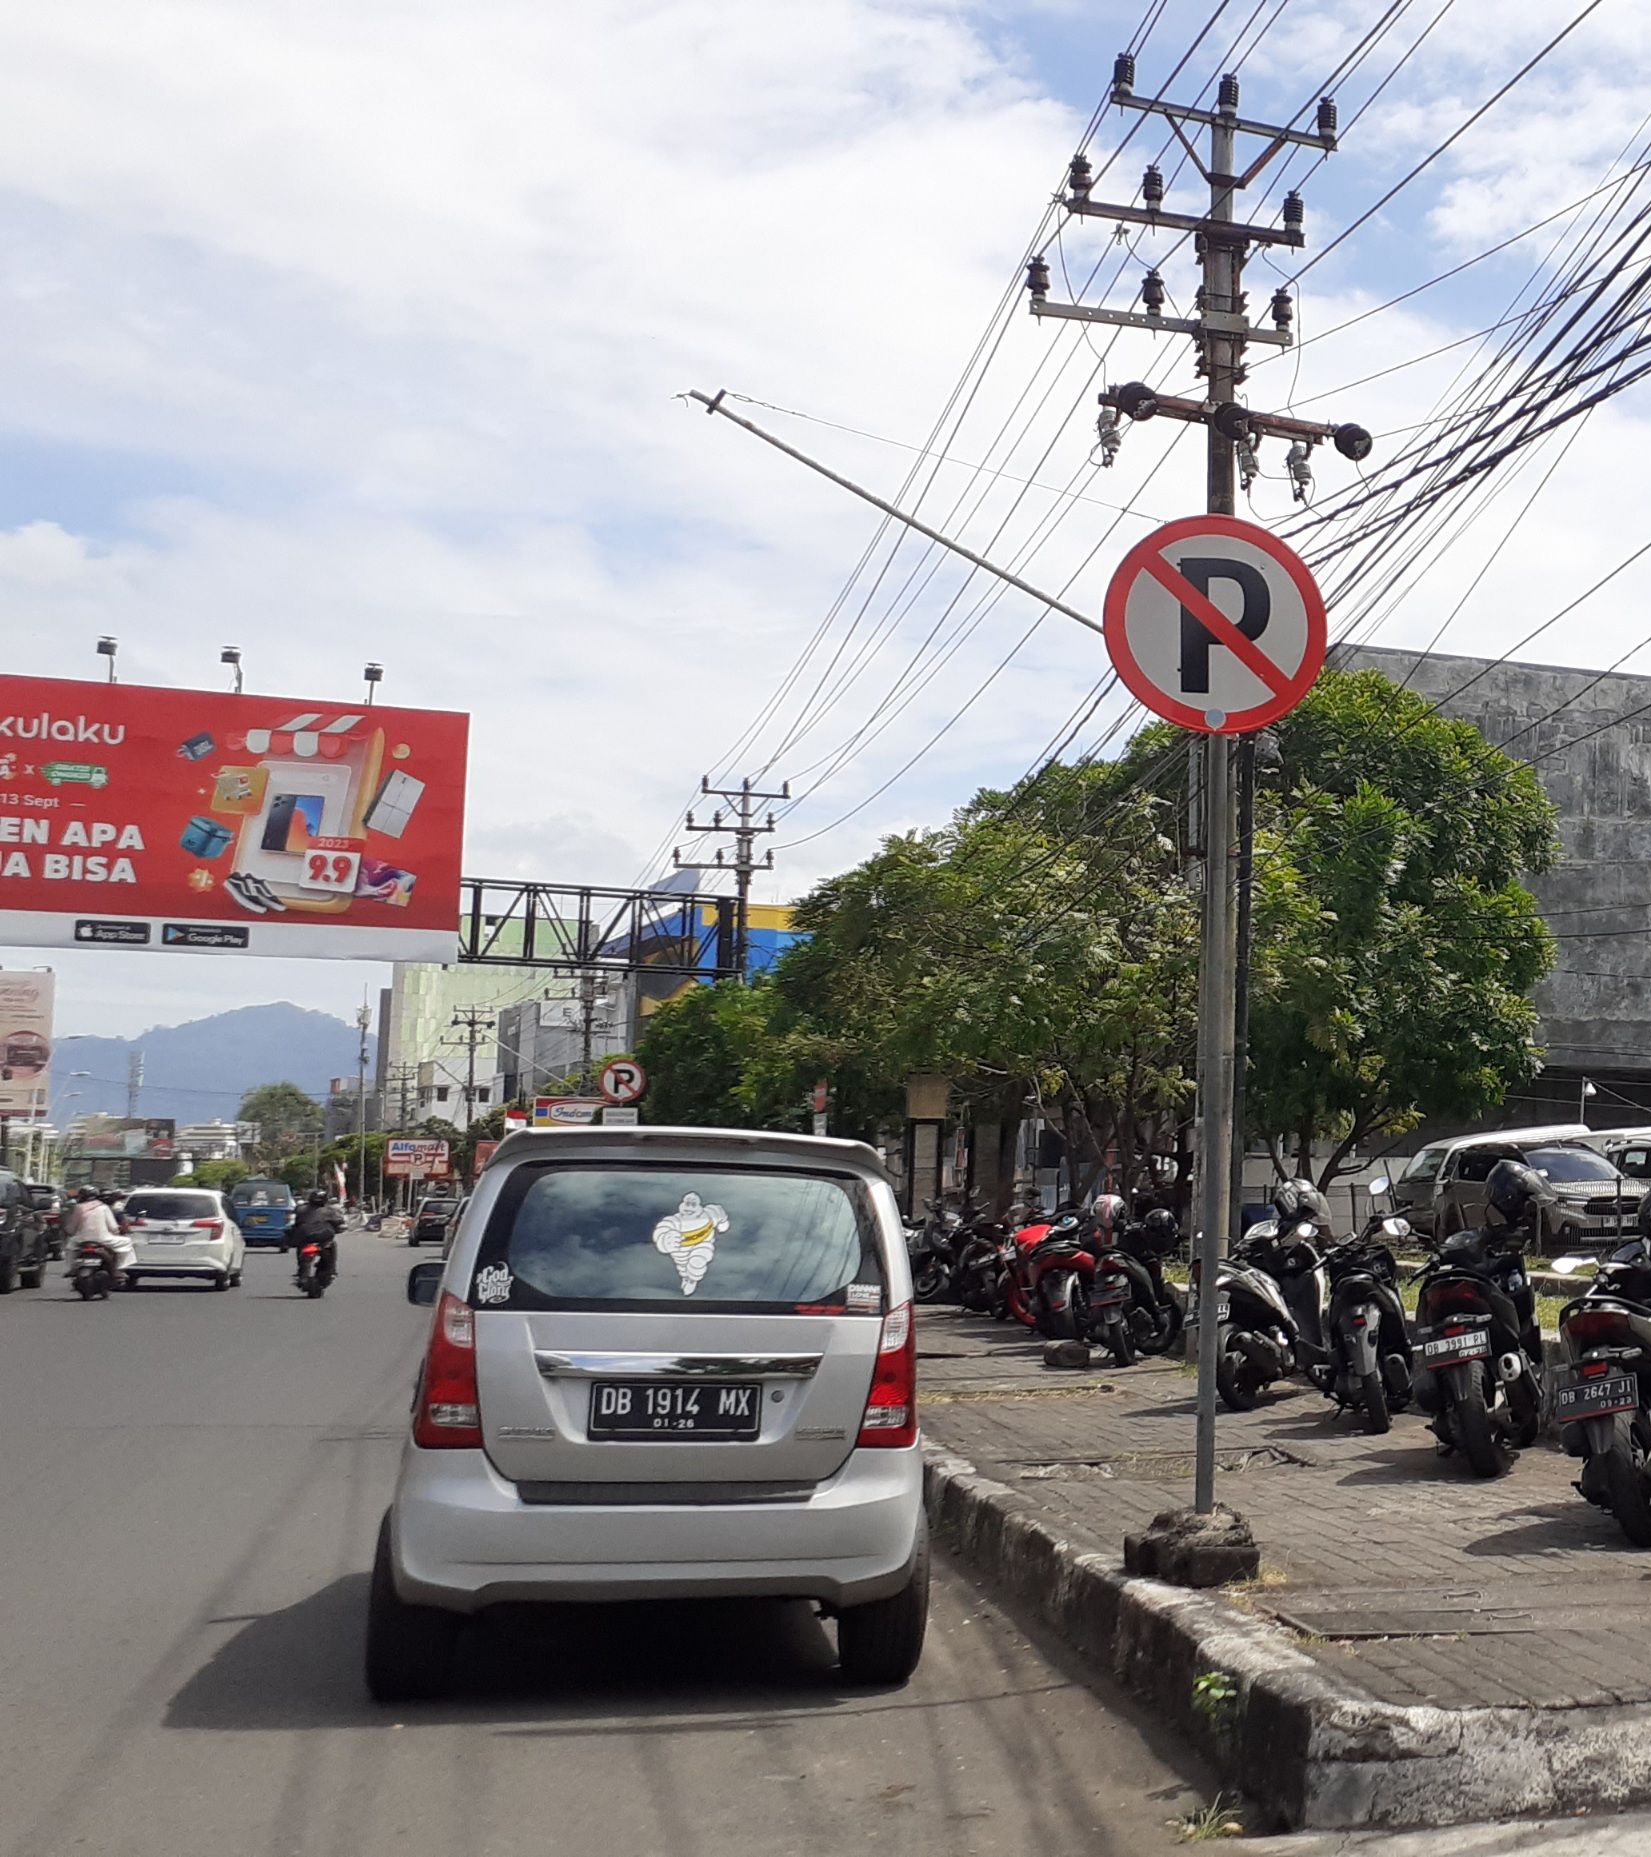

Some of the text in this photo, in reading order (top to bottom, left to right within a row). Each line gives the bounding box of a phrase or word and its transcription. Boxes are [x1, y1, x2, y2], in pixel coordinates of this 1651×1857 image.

[1179, 557, 1271, 694] P
[23, 794, 60, 809] Sept
[60, 820, 145, 850] APA
[43, 852, 137, 883] BISA
[309, 854, 353, 883] 9.9
[187, 932, 245, 946] Google Play
[612, 1069, 634, 1094] P
[391, 1142, 446, 1152] Alfamart
[1445, 1337, 1467, 1351] 3991
[600, 1387, 752, 1416] DB 1914 MX
[1561, 1391, 1576, 1405] DB
[1584, 1383, 1611, 1400] 2647
